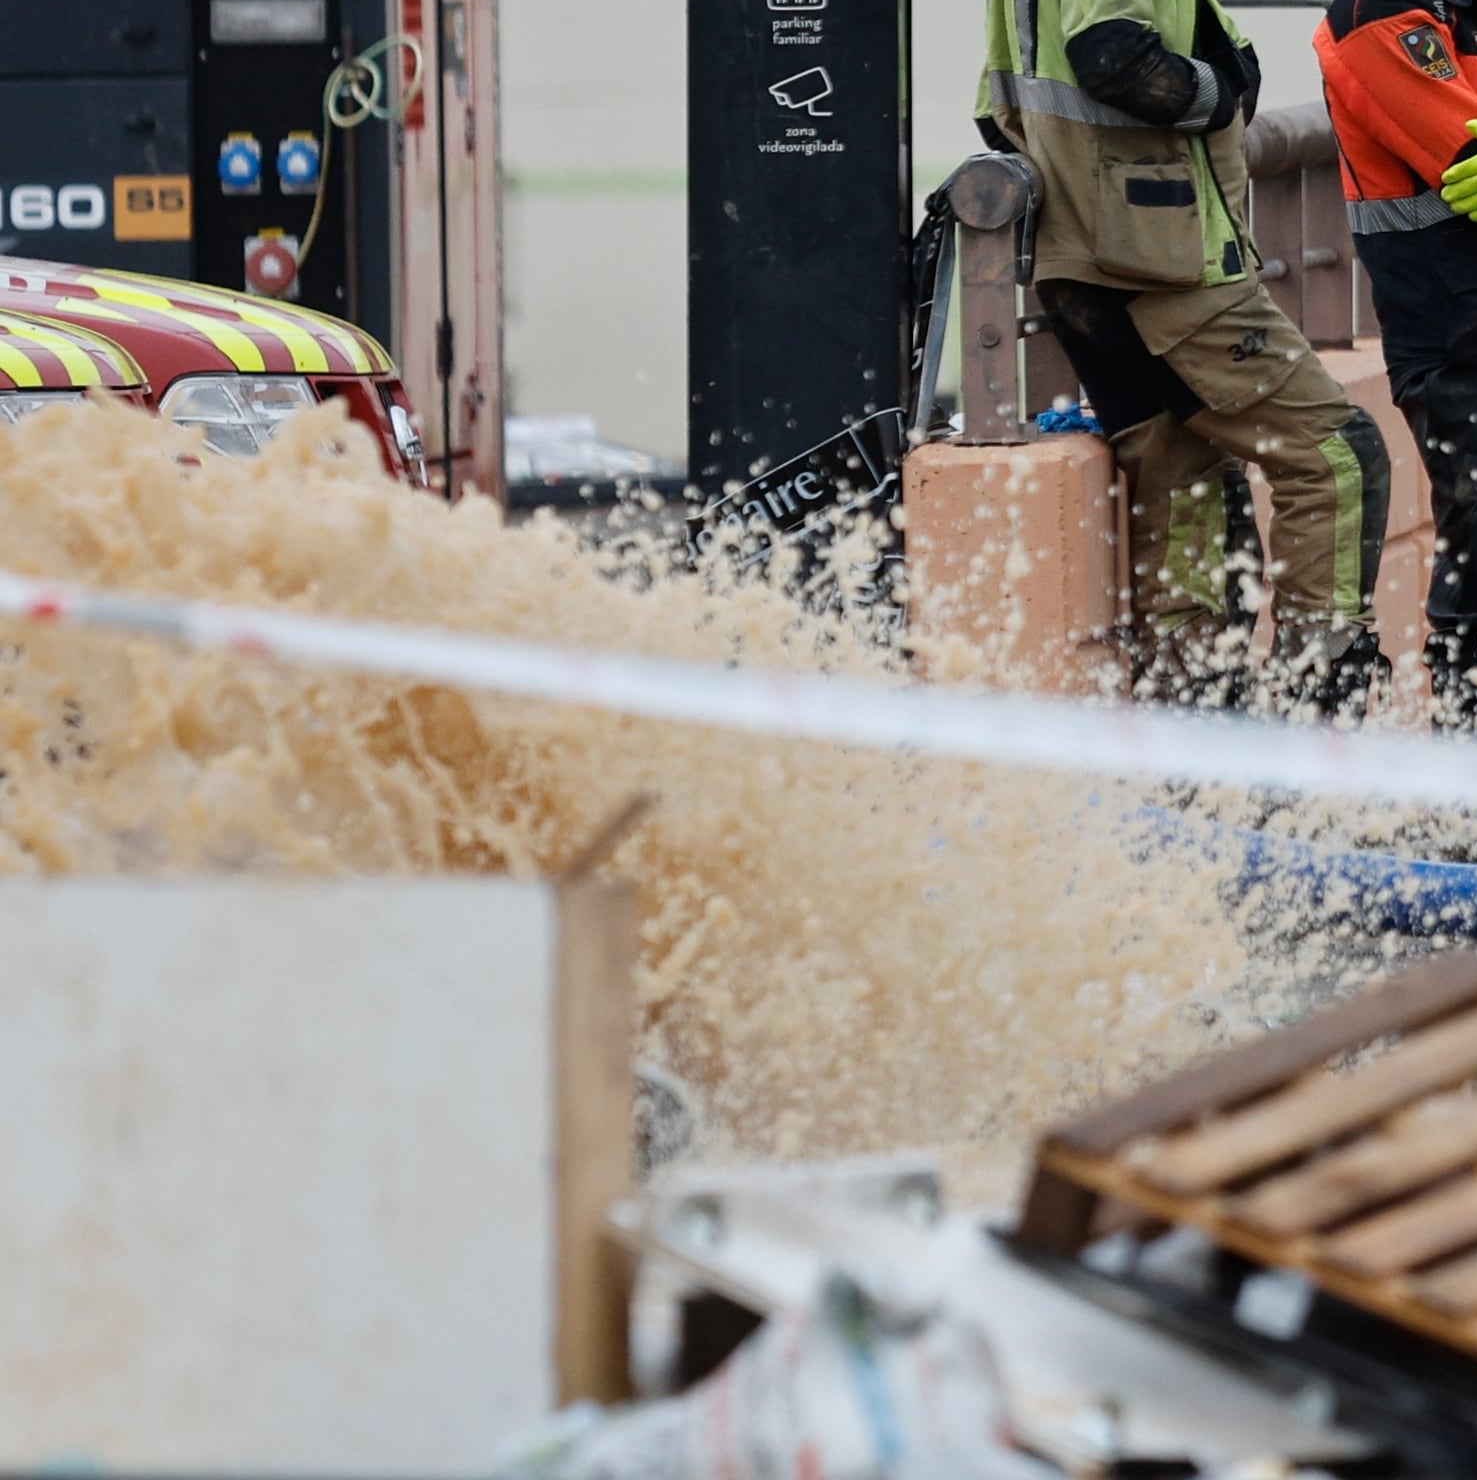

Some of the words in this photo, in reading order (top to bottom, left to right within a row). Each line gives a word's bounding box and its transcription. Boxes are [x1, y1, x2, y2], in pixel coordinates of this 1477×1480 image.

[772, 16, 822, 32] parking
[772, 32, 822, 45] familiar
[785, 127, 816, 137] zona
[758, 139, 844, 156] videovigilada
[0, 184, 106, 230] 60
